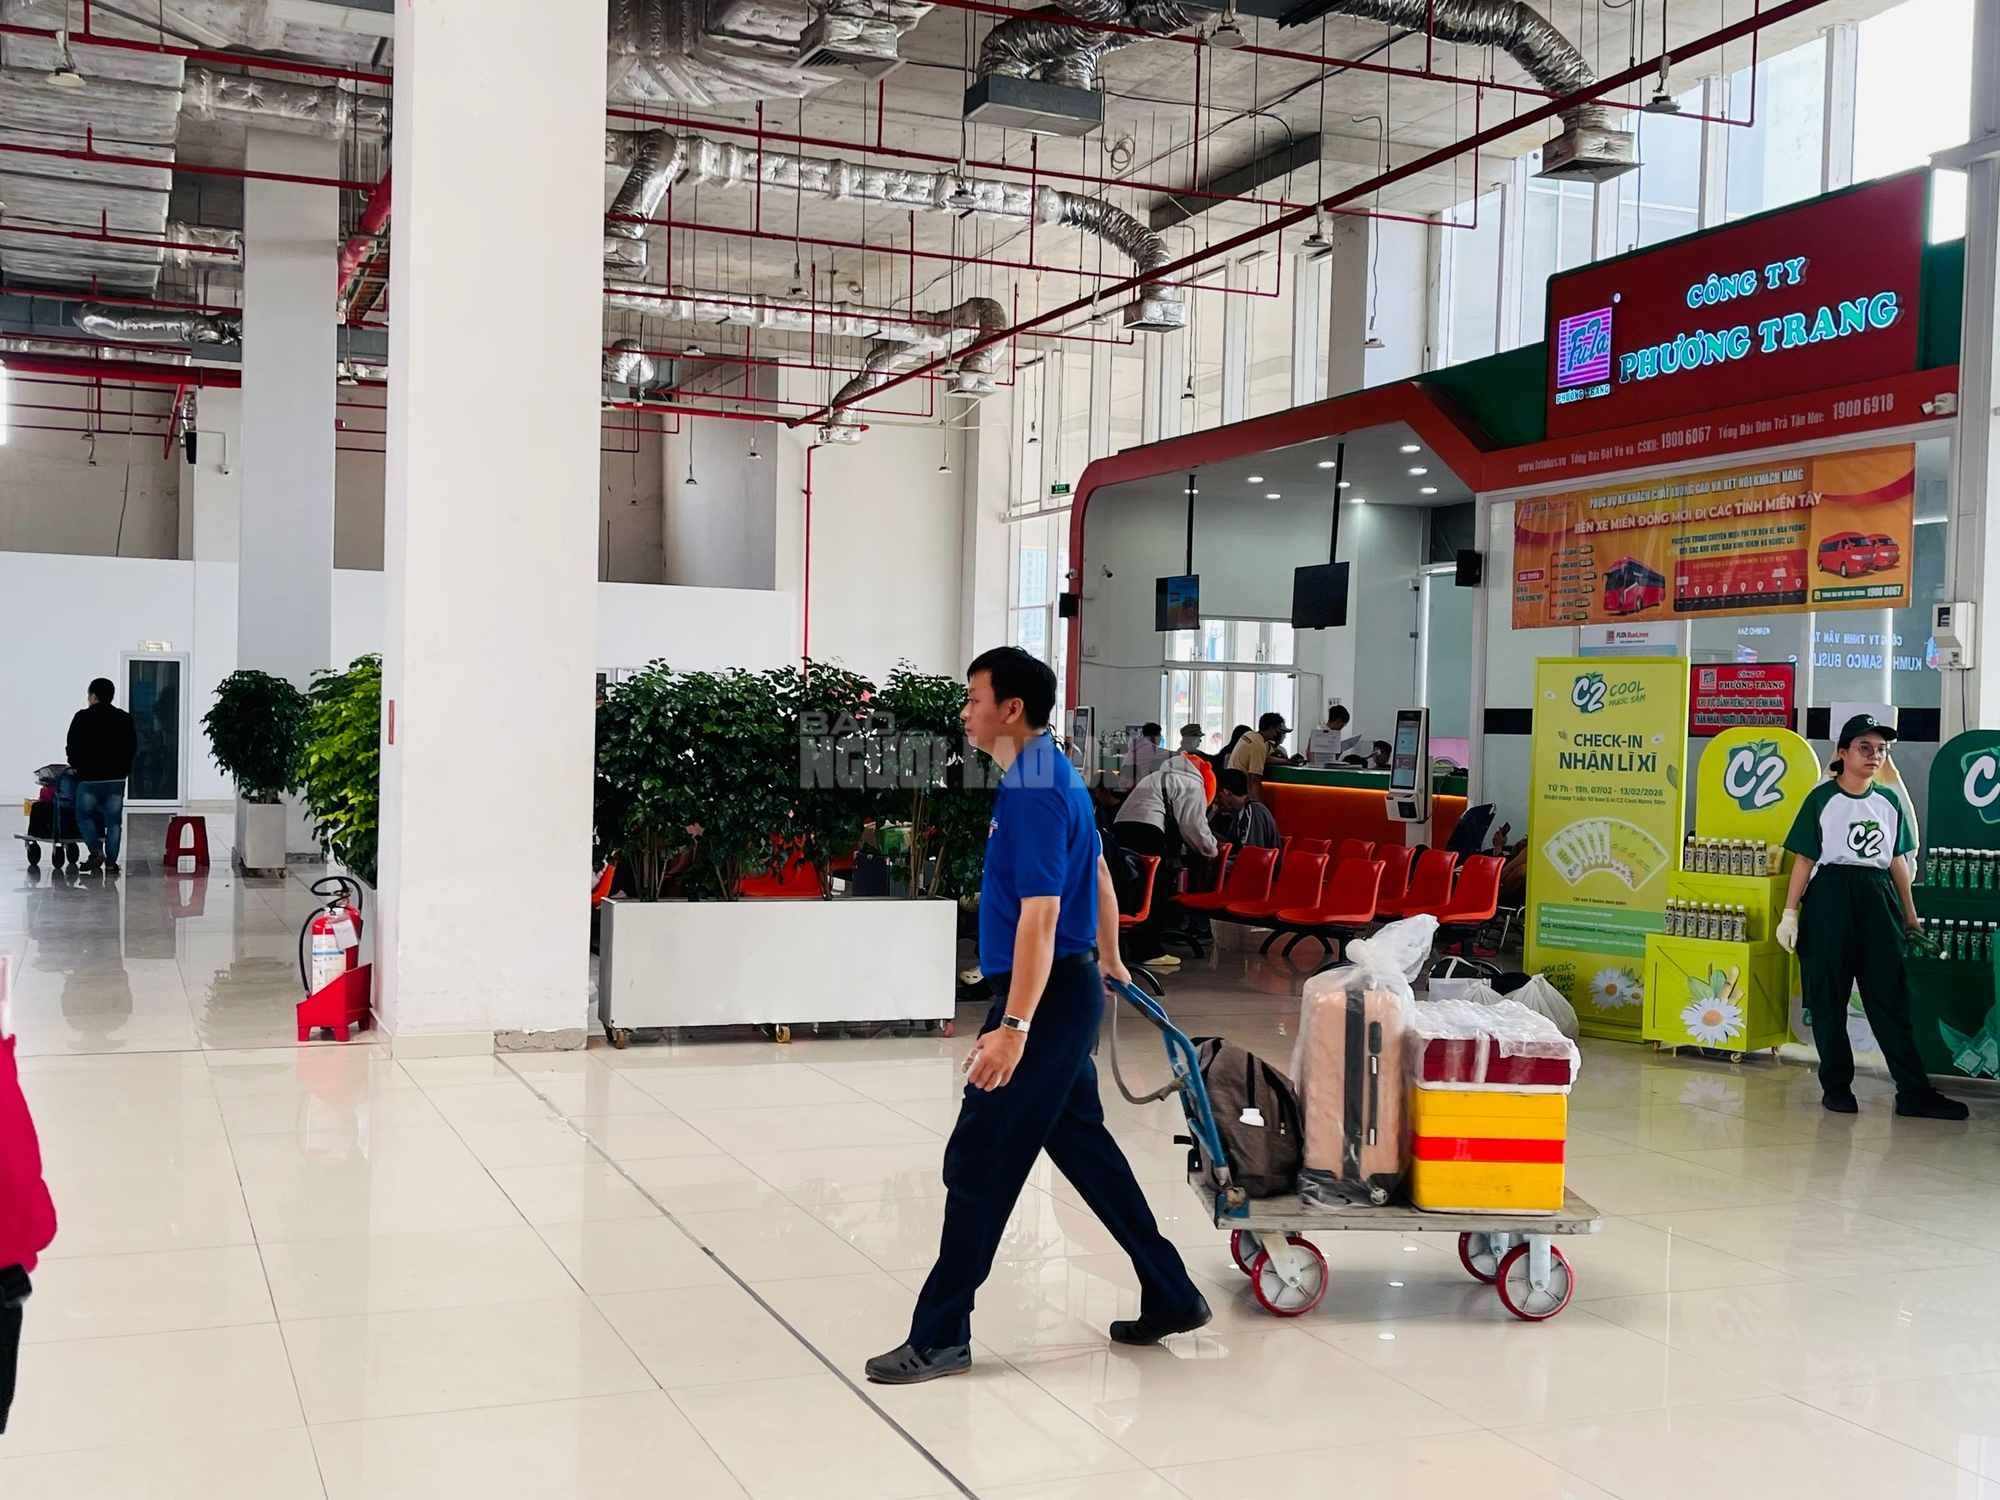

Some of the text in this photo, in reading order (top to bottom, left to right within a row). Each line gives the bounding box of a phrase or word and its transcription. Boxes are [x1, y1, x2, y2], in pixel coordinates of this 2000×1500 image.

[1687, 256, 1805, 309] CÔNG TY
[1619, 291, 1898, 383] PHƯƠNG TRANG
[1585, 384, 1611, 399] TRANG
[1571, 450, 1587, 465] Tổng
[1637, 439, 1659, 453] CSKH:
[1661, 430, 1684, 449] 1900
[1685, 425, 1711, 445] 6067
[1719, 423, 1738, 439] Tổng
[1774, 414, 1788, 430] Trả
[1791, 413, 1806, 429] Tận
[1833, 399, 1860, 420] 1900
[1863, 393, 1894, 415] 6918
[1596, 520, 1609, 531] XE
[1672, 507, 1692, 522] MỚI
[1695, 506, 1706, 520] ĐI
[1709, 501, 1732, 518] CÁC
[1799, 490, 1822, 507] TÂY
[1867, 587, 1882, 597] 1900
[1571, 677, 1607, 713] C2
[1609, 680, 1646, 697] COOL
[1719, 680, 1753, 690] PHƯƠNG
[1755, 680, 1785, 690] TRANG
[1574, 733, 1643, 749] CHECK-IN
[1559, 750, 1613, 773] NHẬN
[1575, 785, 1589, 794] 19h,
[1591, 786, 1612, 794] 07/02
[1620, 787, 1663, 796] 13/02/2026
[1724, 748, 1787, 808] C2
[1964, 755, 2000, 808] C
[1847, 823, 1884, 858] C2
[1541, 961, 1572, 973] HOA CÚC
